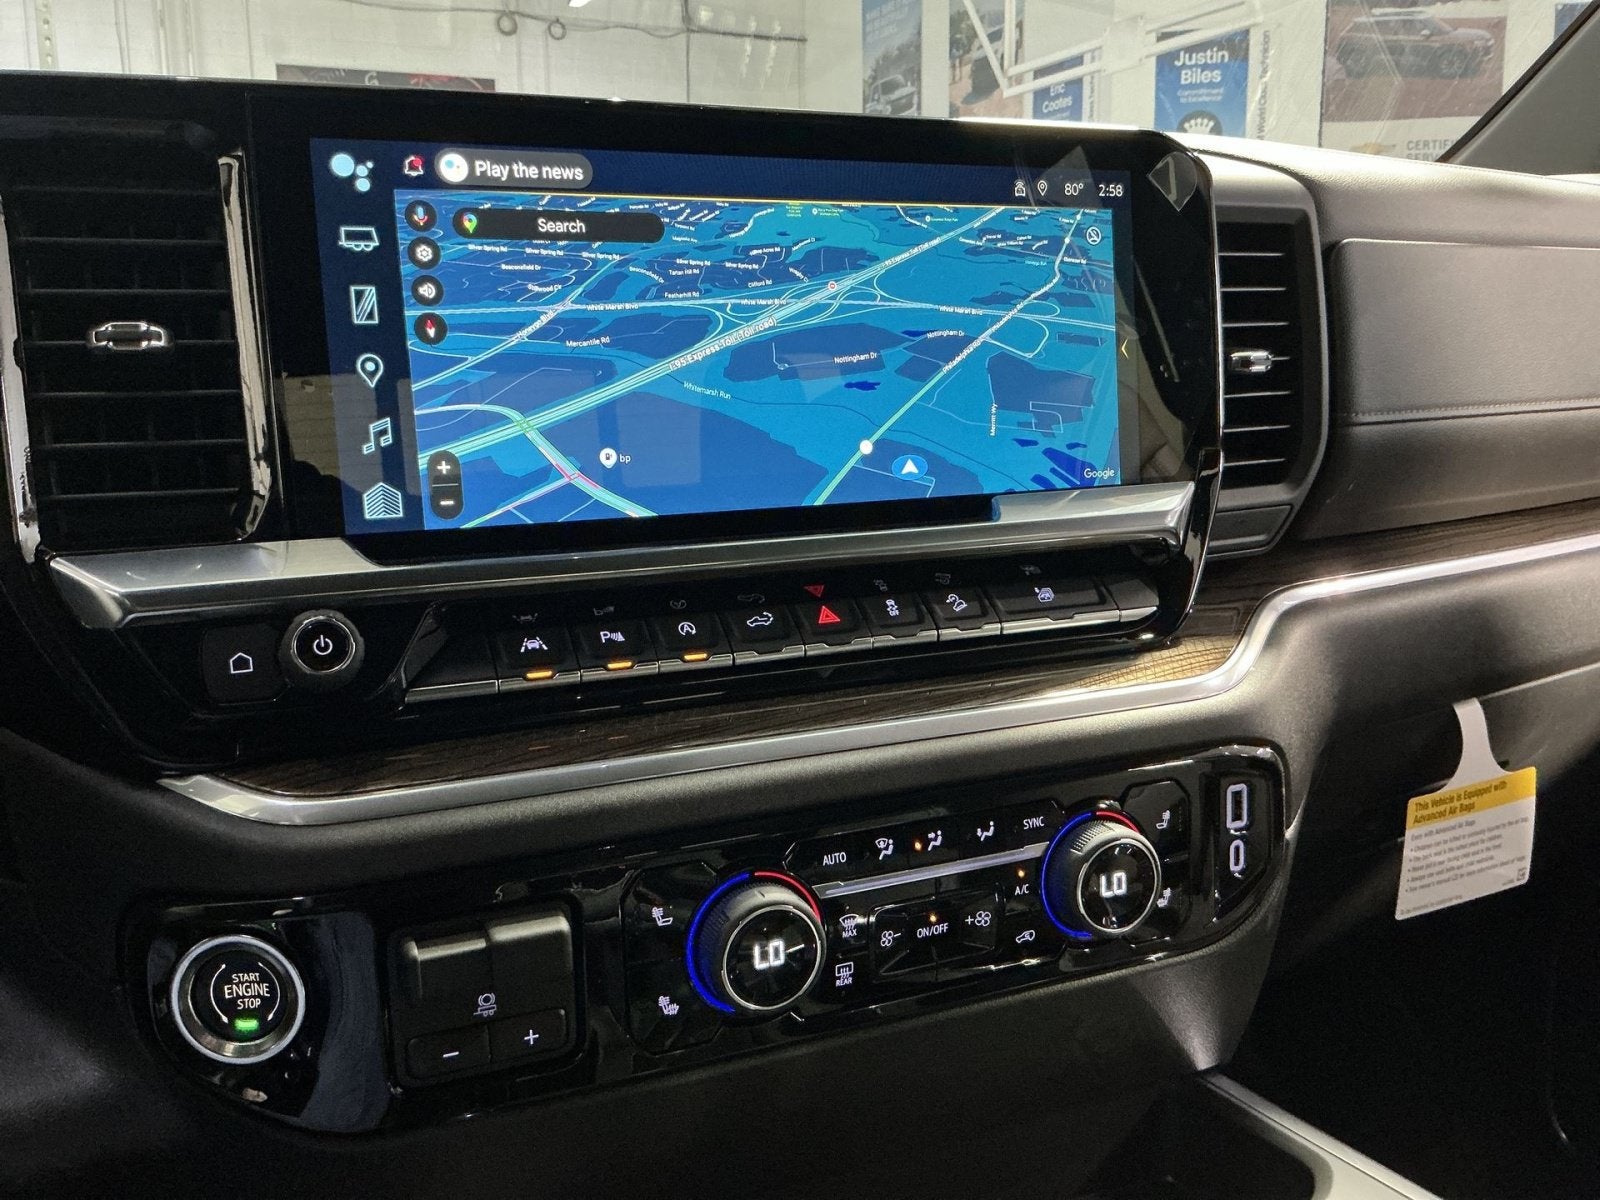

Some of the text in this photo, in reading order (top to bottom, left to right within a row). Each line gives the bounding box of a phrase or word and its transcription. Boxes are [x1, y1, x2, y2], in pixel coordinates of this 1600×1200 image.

[1174, 47, 1229, 67] Justin
[1180, 67, 1222, 85] Biles
[475, 160, 584, 181] Play the news
[1098, 184, 1123, 197] 2:58
[537, 217, 586, 233] Search
[597, 252, 612, 261] Spring
[600, 335, 610, 344] Rd
[834, 352, 877, 364] Nottingham Dr
[719, 391, 731, 400] Run
[619, 453, 631, 464] bp
[1083, 467, 1115, 479] Google
[1414, 800, 1429, 813] This
[1456, 793, 1462, 801] is
[1413, 808, 1447, 825] Advanced
[1448, 806, 1458, 815] Air
[1023, 816, 1045, 830] SYNC
[823, 852, 847, 866] AUTO
[1014, 883, 1030, 895] A/C
[842, 928, 858, 938] MAX
[916, 922, 949, 938] ON/OFF
[232, 972, 260, 983] START
[835, 977, 853, 987] REAR
[224, 983, 270, 999] ENGINE
[237, 998, 261, 1010] STOP
